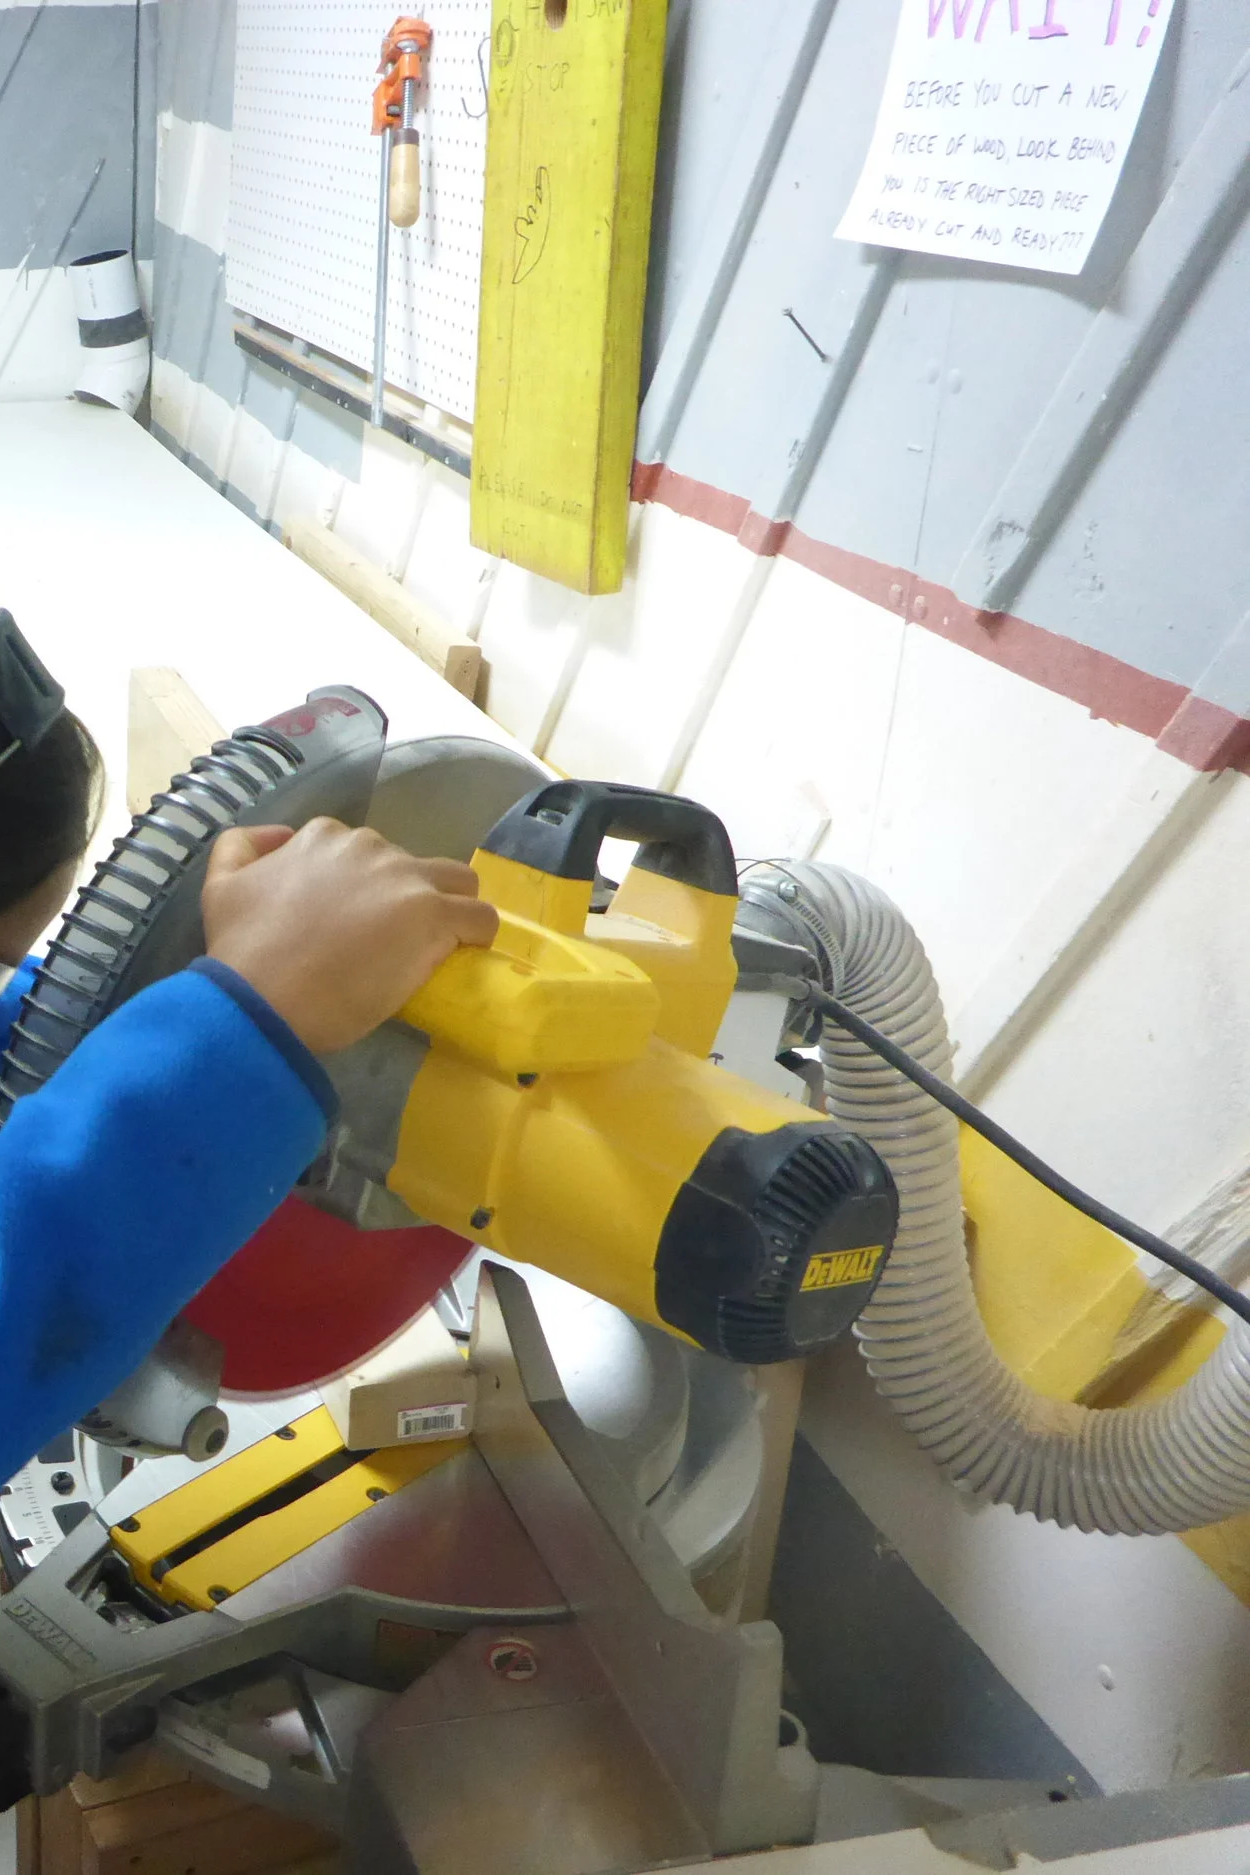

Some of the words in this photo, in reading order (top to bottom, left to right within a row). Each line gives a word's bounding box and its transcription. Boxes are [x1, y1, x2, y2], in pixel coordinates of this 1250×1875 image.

[904, 79, 964, 108] BEFORE
[974, 78, 1002, 107] YOU
[1012, 82, 1050, 107] CUT
[1057, 81, 1074, 105] A
[1085, 84, 1128, 111] NEW
[892, 131, 939, 155] PIECE
[945, 133, 967, 156] OF
[1016, 136, 1061, 159] LOOK
[1067, 136, 1117, 164] BEHIND
[881, 174, 904, 194] YOU
[913, 176, 931, 193] IS
[934, 180, 963, 201] THE
[963, 182, 1007, 205] RIGHT
[1007, 187, 1046, 209] SIZED
[1051, 190, 1089, 213] PIECE
[868, 208, 929, 233] ALREADY
[934, 221, 964, 237] CUT
[970, 224, 1002, 246] AND
[801, 1248, 884, 1287] DEWALT
[4, 1600, 94, 1671] DEWA
